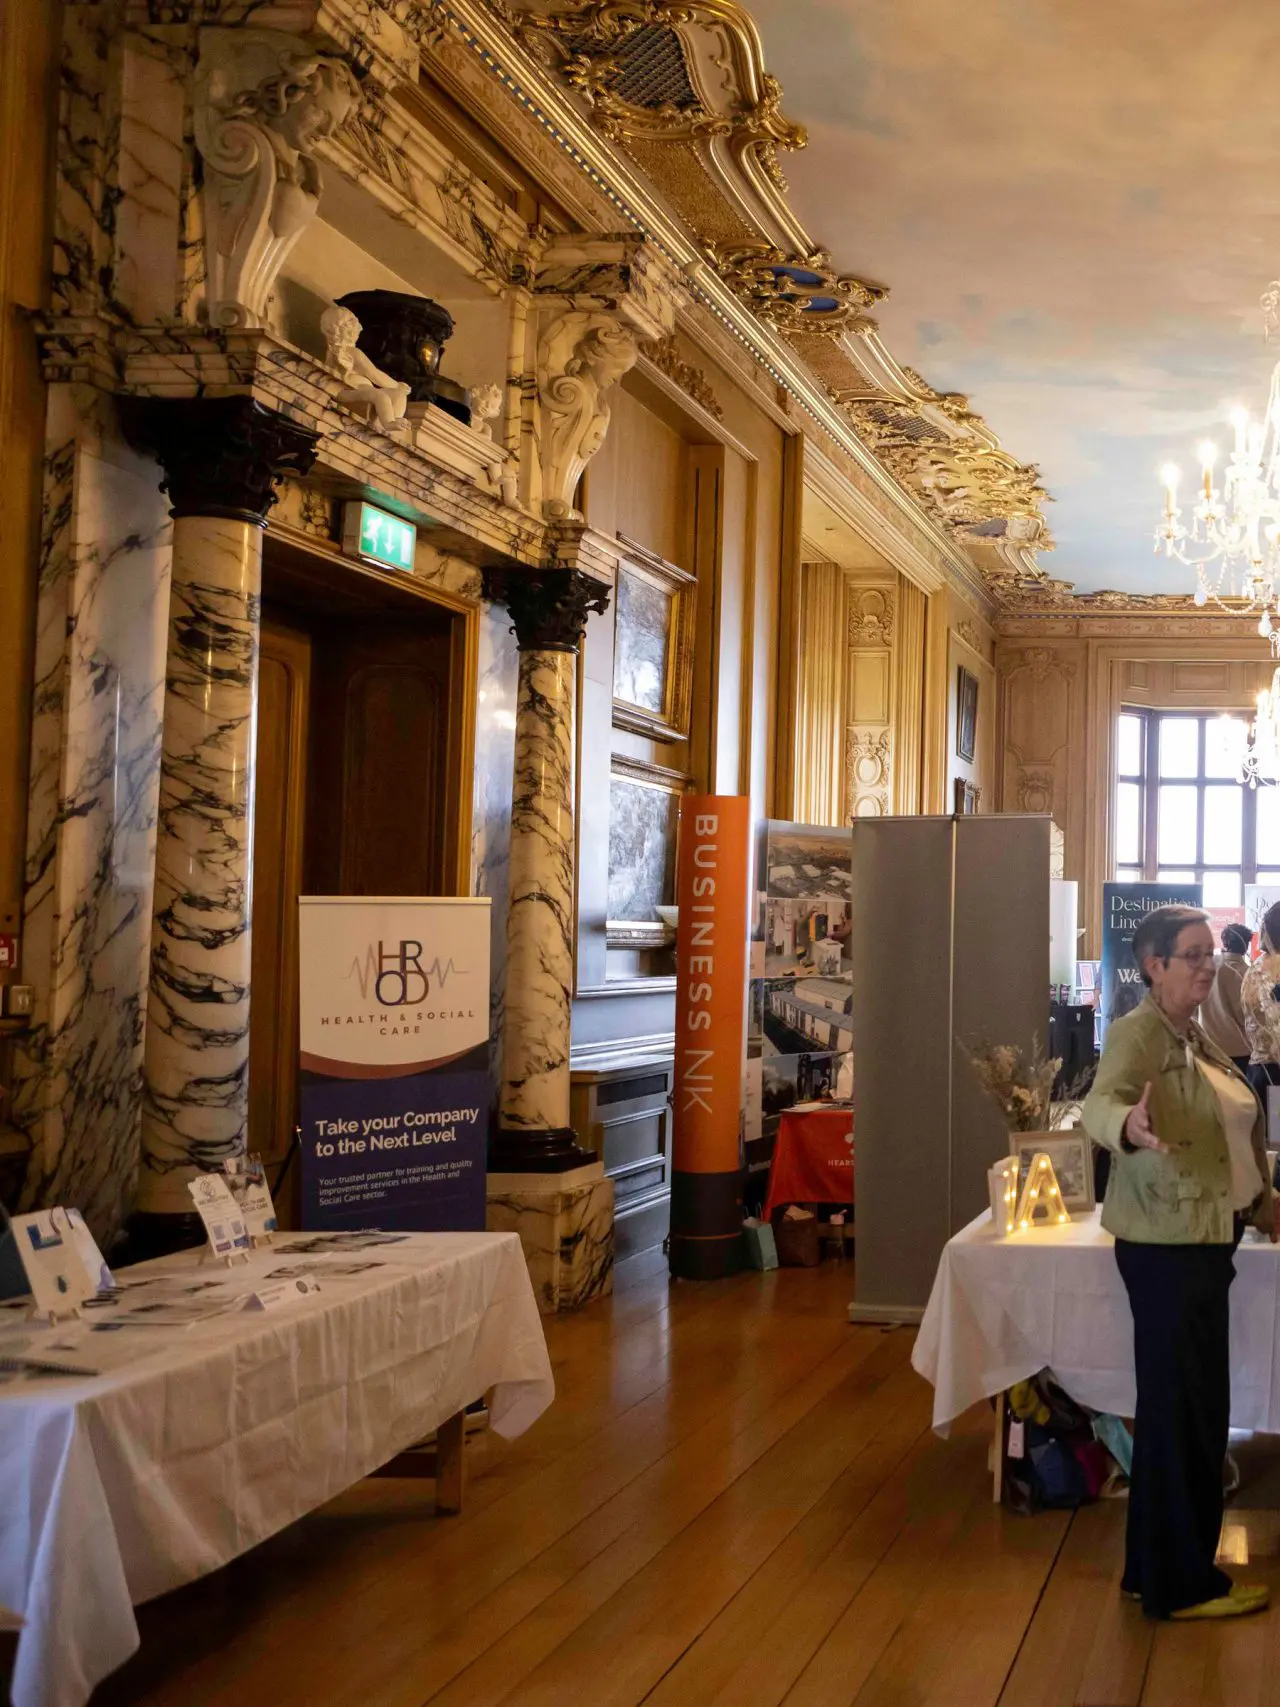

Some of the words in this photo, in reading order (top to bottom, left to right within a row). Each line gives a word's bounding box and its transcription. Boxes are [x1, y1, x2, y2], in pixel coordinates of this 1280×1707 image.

[688, 815, 718, 1030] BUSINESS
[321, 1014, 388, 1025] HEALTH
[399, 1013, 406, 1021] &
[417, 1010, 475, 1021] SOCIAL
[380, 1026, 421, 1036] CARE
[683, 1050, 714, 1114] NK
[315, 1118, 359, 1136] Take
[362, 1116, 401, 1135] your
[403, 1108, 480, 1126] Company
[315, 1141, 335, 1157] to
[338, 1138, 367, 1154] the
[370, 1132, 409, 1150] Next
[412, 1127, 457, 1146] Level
[319, 1178, 337, 1186] Your
[338, 1174, 364, 1184] trusted
[366, 1169, 394, 1181] partner
[395, 1168, 406, 1176] for
[406, 1164, 434, 1175] training
[435, 1162, 448, 1171] and
[450, 1159, 473, 1169] quality
[319, 1183, 368, 1196] improvement
[370, 1179, 400, 1189] services
[408, 1175, 421, 1183] the
[422, 1172, 446, 1181] Health
[447, 1169, 460, 1178] and
[319, 1196, 342, 1206] Social
[344, 1193, 361, 1202] Care
[362, 1190, 388, 1200] sector.
